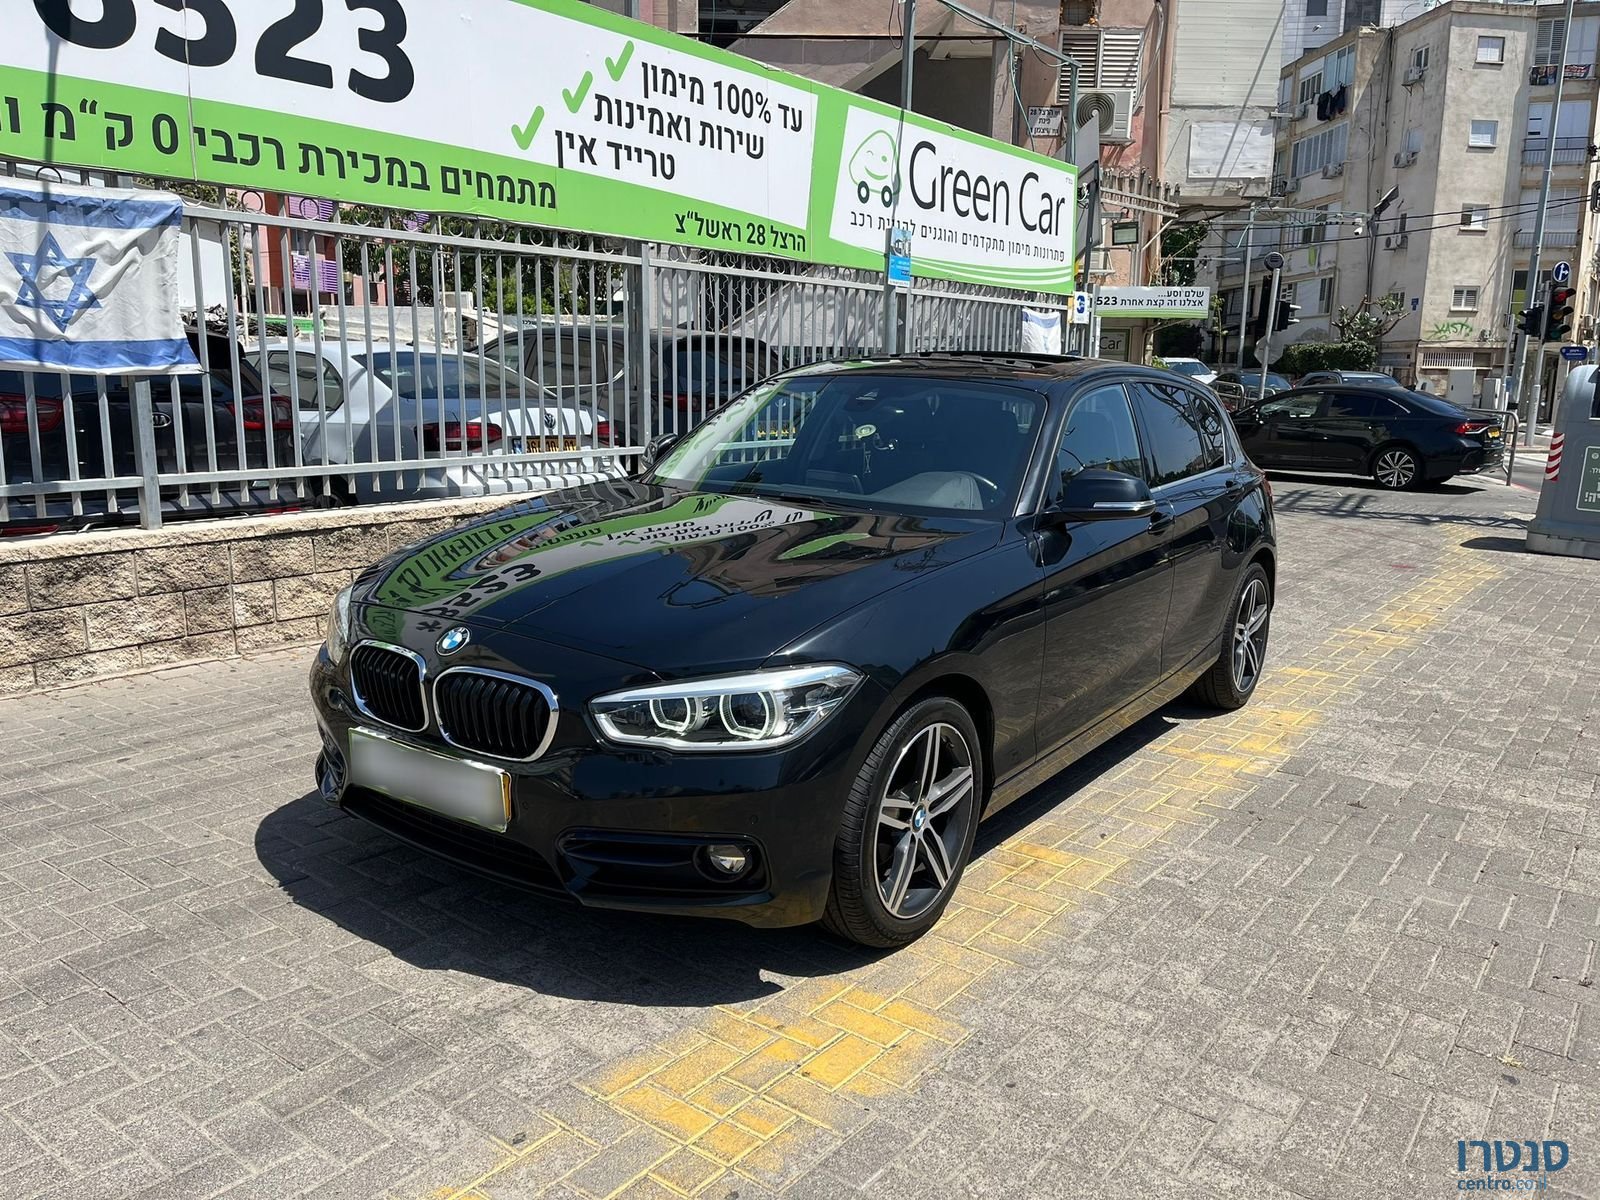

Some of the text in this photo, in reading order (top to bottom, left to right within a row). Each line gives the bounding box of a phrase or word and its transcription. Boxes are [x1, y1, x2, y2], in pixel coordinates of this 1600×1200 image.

[642, 62, 802, 132] עד 100% מימון
[152, 113, 179, 155] 0
[594, 93, 764, 159] שירות ואמינות
[193, 126, 285, 170] רכבי
[555, 130, 675, 180] טרייד אין
[298, 142, 430, 191] במכירת
[441, 166, 556, 209] מתמחים
[909, 140, 1065, 236] Green Car
[850, 211, 873, 228] רכב
[747, 223, 766, 246] 28
[770, 225, 806, 252] הרצל
[920, 225, 957, 244] והוגנים
[961, 235, 1005, 252] מתקדמים
[1008, 240, 1031, 257] מימון
[1033, 245, 1065, 262] פתרונות
[1146, 300, 1164, 308] קצת
[1185, 290, 1204, 298] שלם
